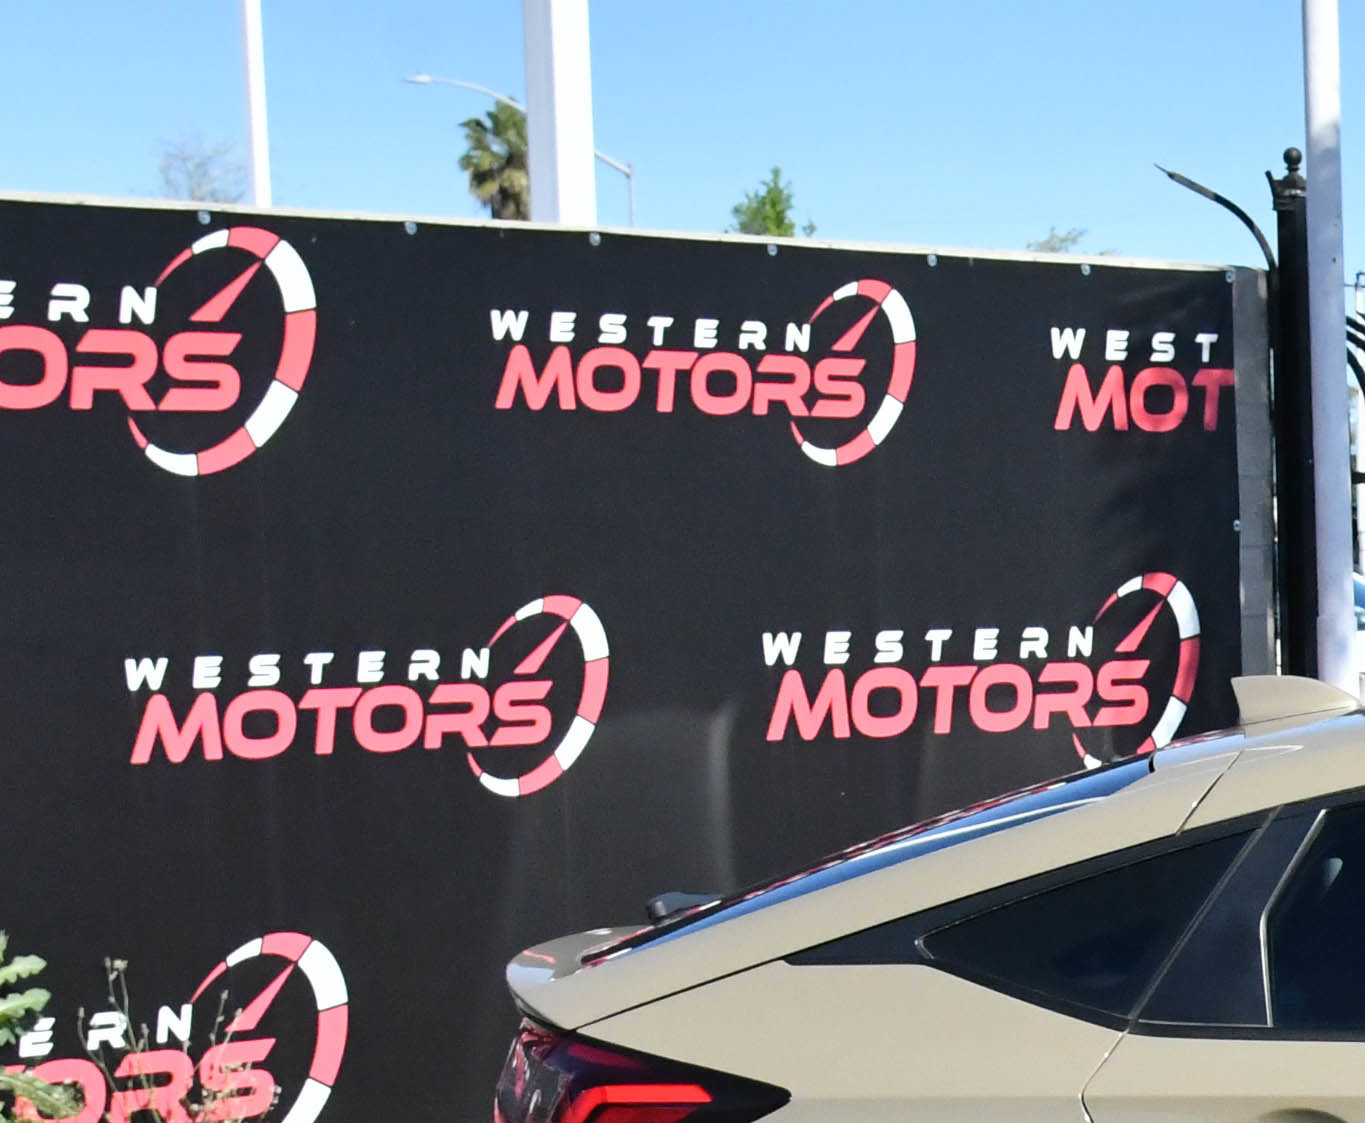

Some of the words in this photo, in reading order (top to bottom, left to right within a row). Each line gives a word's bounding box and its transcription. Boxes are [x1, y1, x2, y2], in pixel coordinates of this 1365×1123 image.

[490, 309, 811, 353] WESTERN
[1050, 326, 1218, 363] WEST
[494, 343, 867, 419] MOTORS
[1053, 362, 1236, 433] MOT
[124, 647, 490, 692] WESTERN
[762, 625, 1094, 666] WESTERN
[129, 679, 554, 765] MOTORS
[765, 657, 1151, 742] MOTORS
